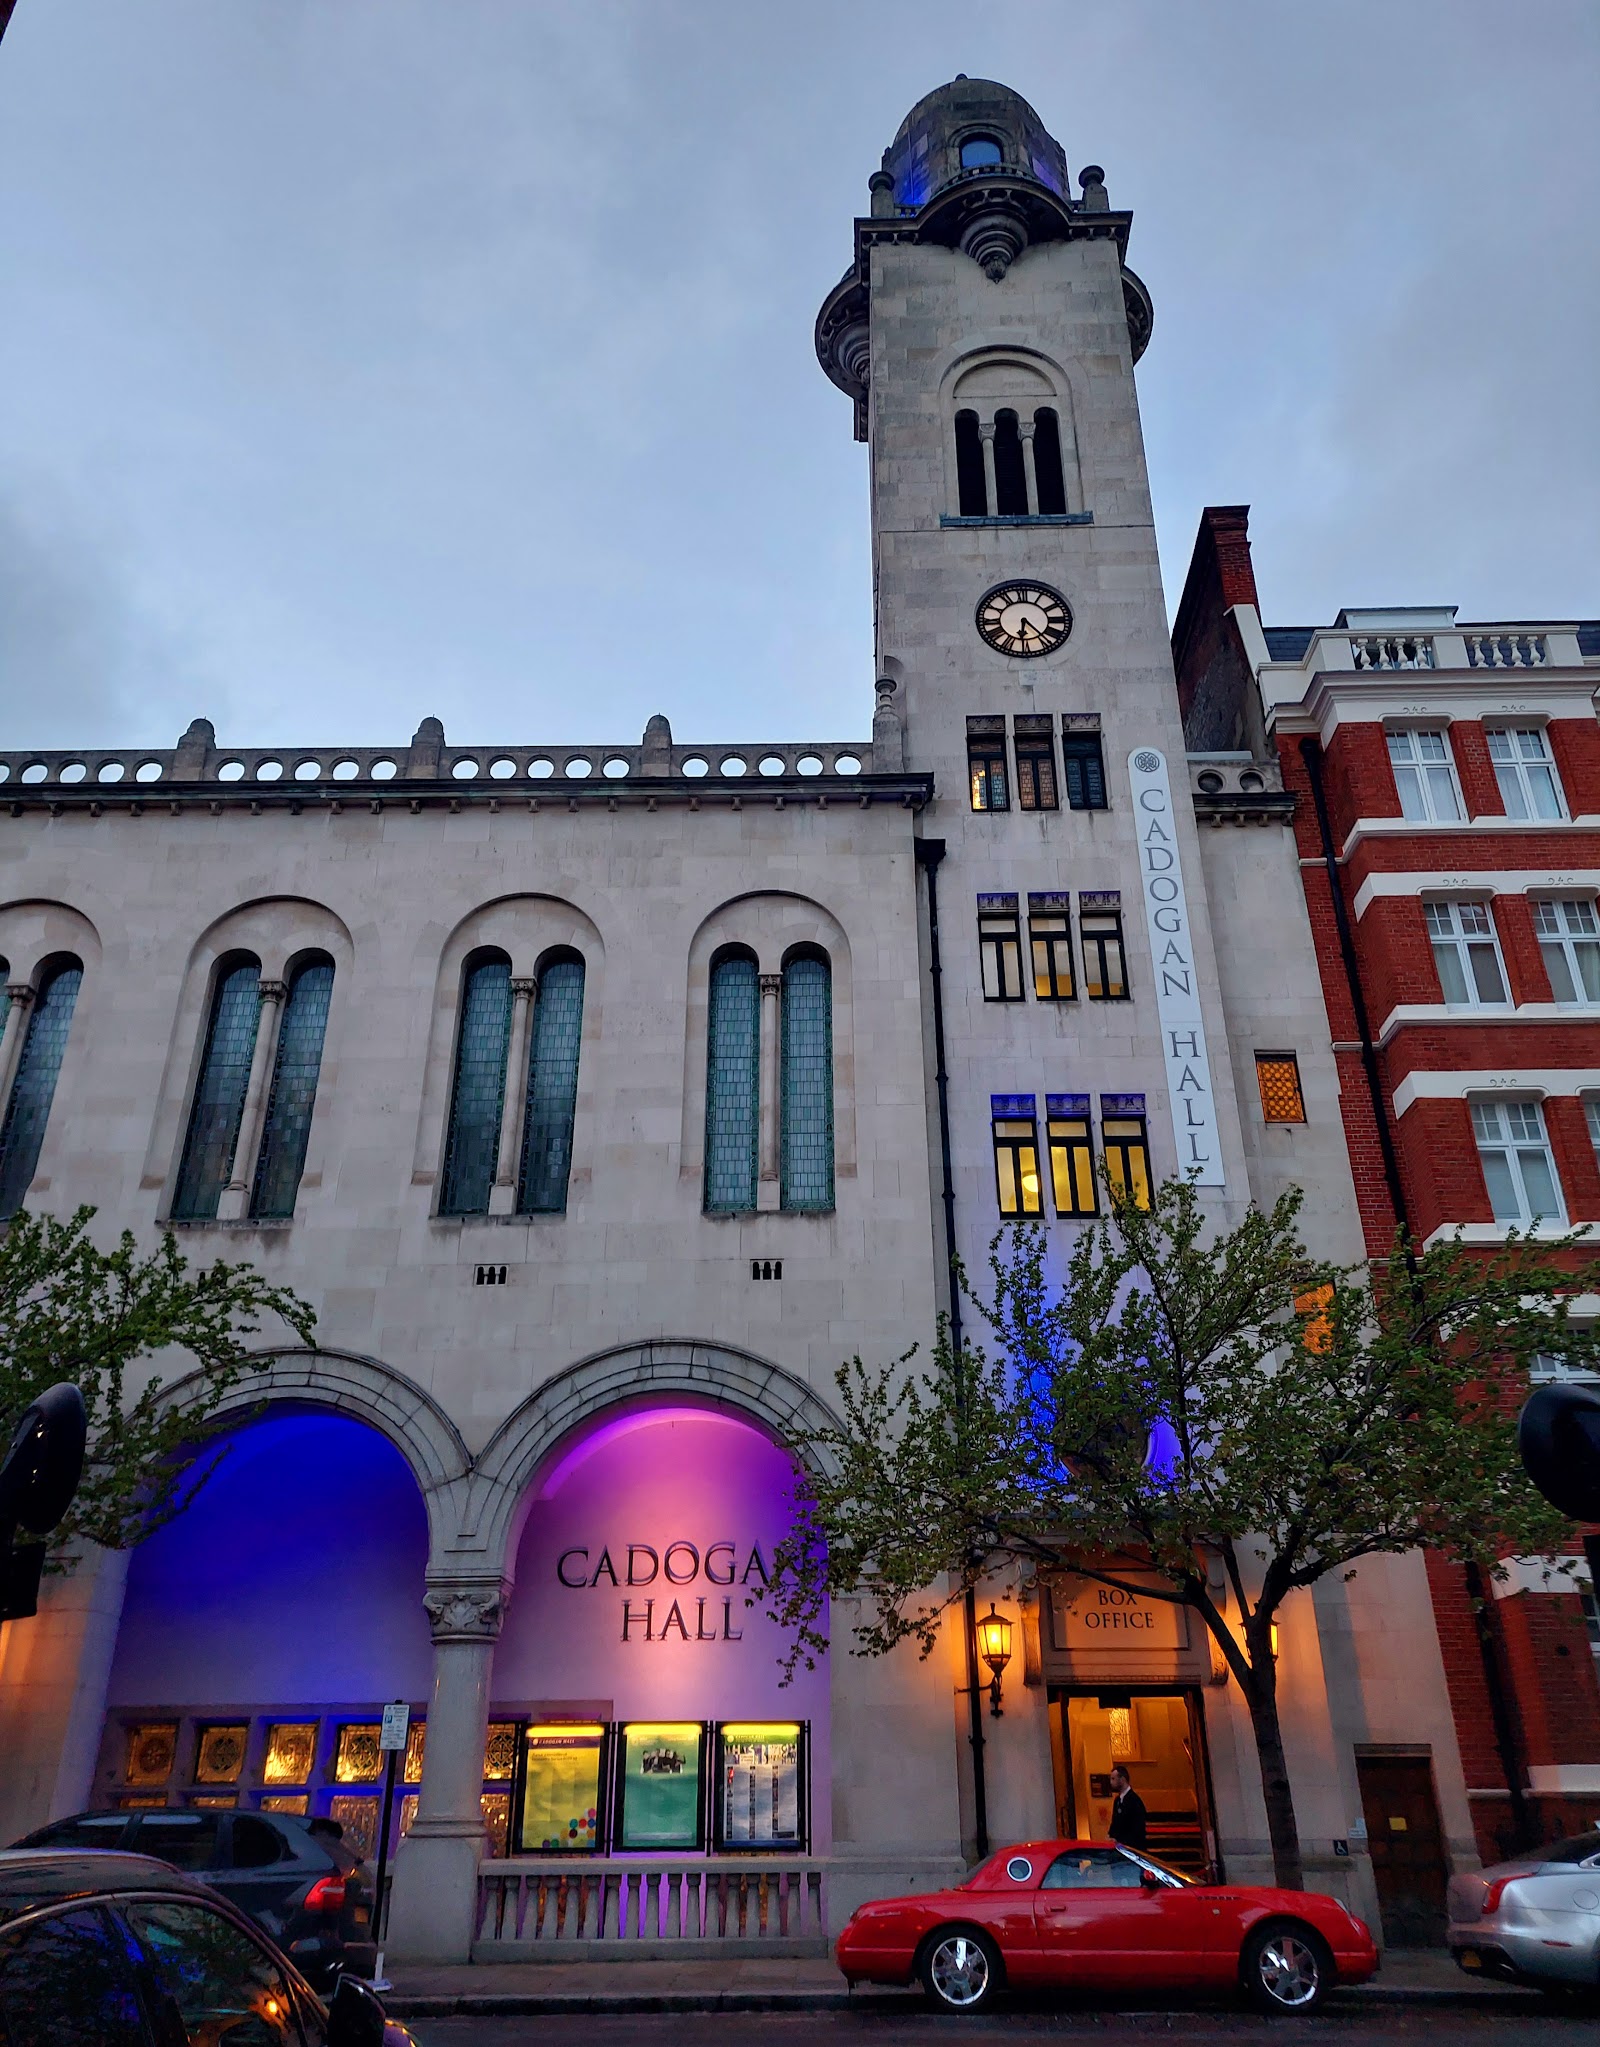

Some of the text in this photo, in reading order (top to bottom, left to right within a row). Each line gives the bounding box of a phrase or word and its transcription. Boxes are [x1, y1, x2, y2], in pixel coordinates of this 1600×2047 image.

[1140, 788, 1210, 1162] CADOGAN HALL
[557, 1540, 799, 1588] CADOGA
[620, 1596, 744, 1643] HALL
[1085, 1612, 1154, 1629] OFFICE
[1098, 1589, 1138, 1606] BOX
